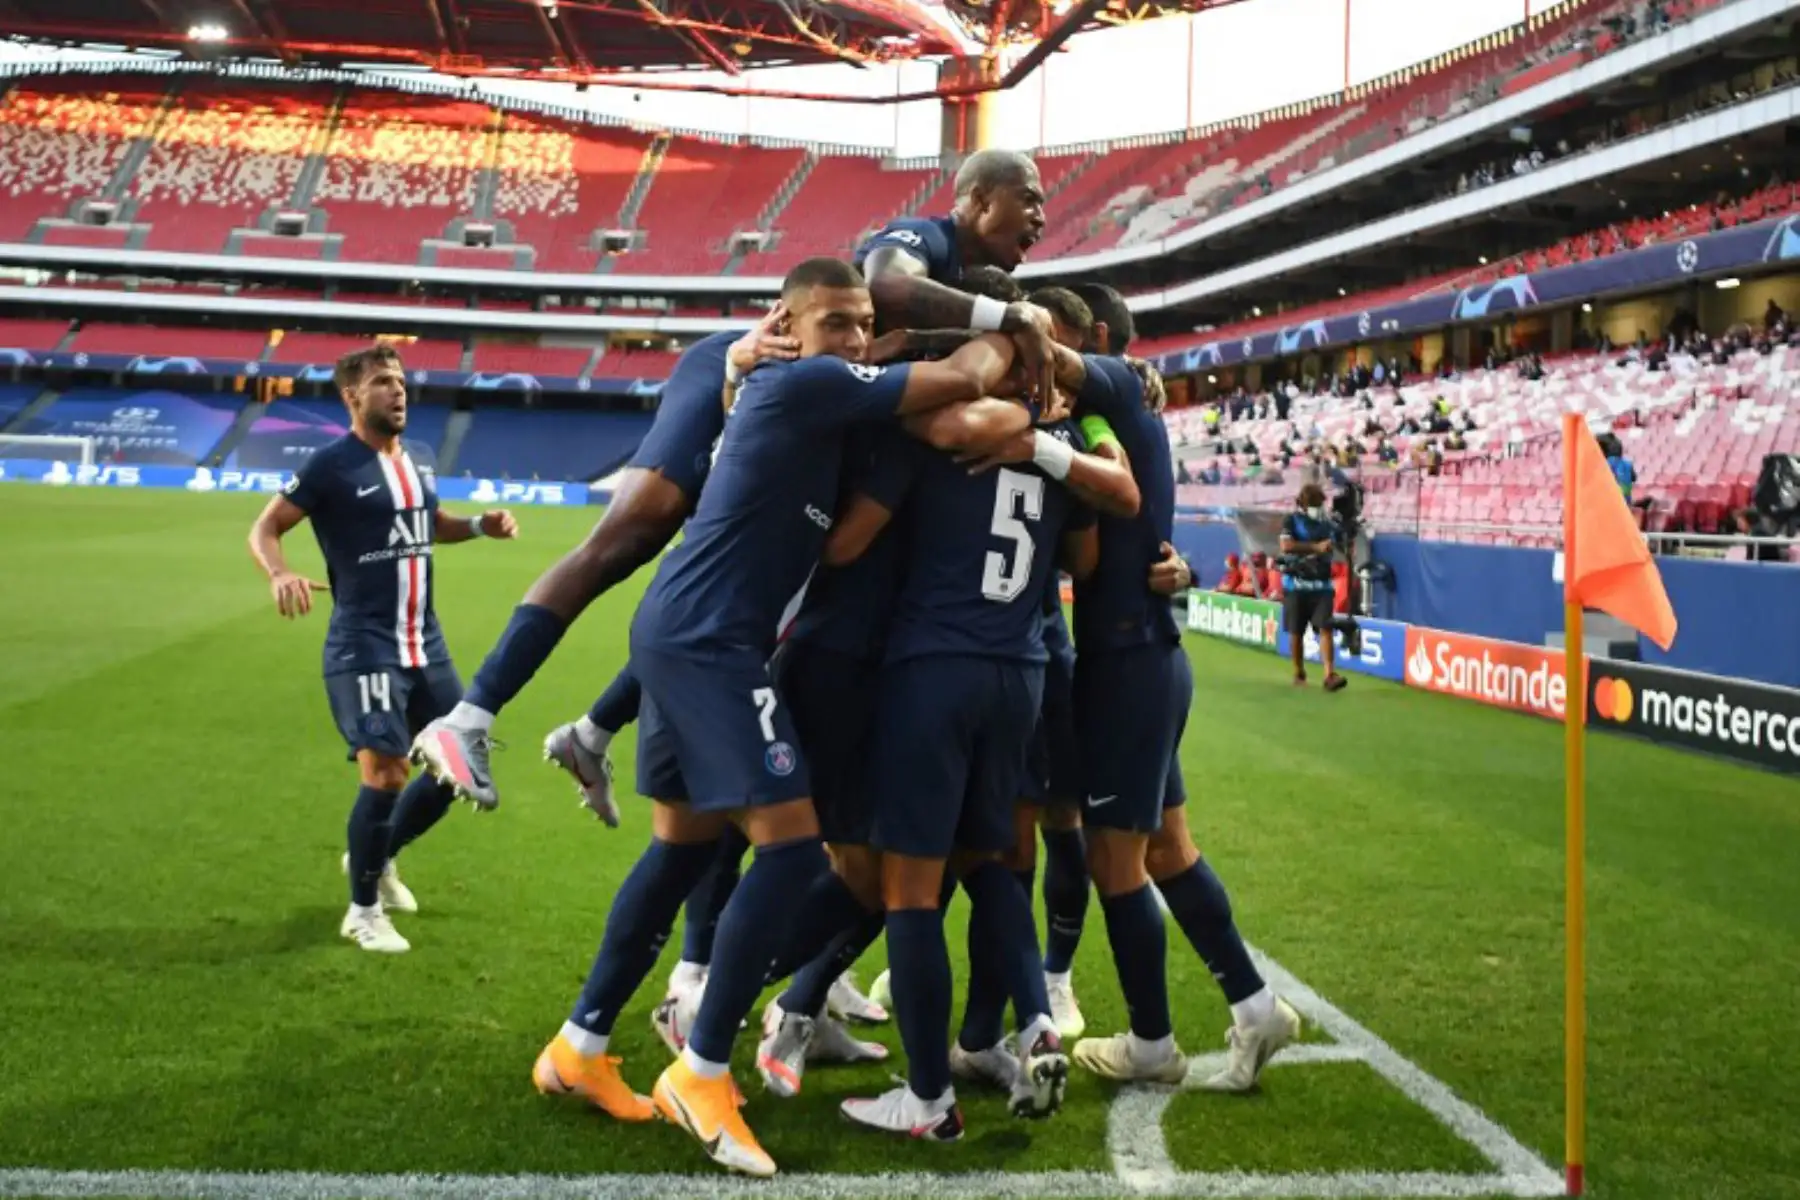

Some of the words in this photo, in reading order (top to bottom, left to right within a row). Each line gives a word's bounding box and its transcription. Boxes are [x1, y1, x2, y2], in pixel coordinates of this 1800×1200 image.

[76, 464, 140, 486] PS5
[219, 471, 283, 492] PS5
[503, 483, 564, 504] PS5
[981, 467, 1046, 602] 5
[1188, 591, 1263, 642] Heineken
[357, 672, 390, 714] 14
[1434, 640, 1567, 714] Santande
[752, 687, 777, 741] 7
